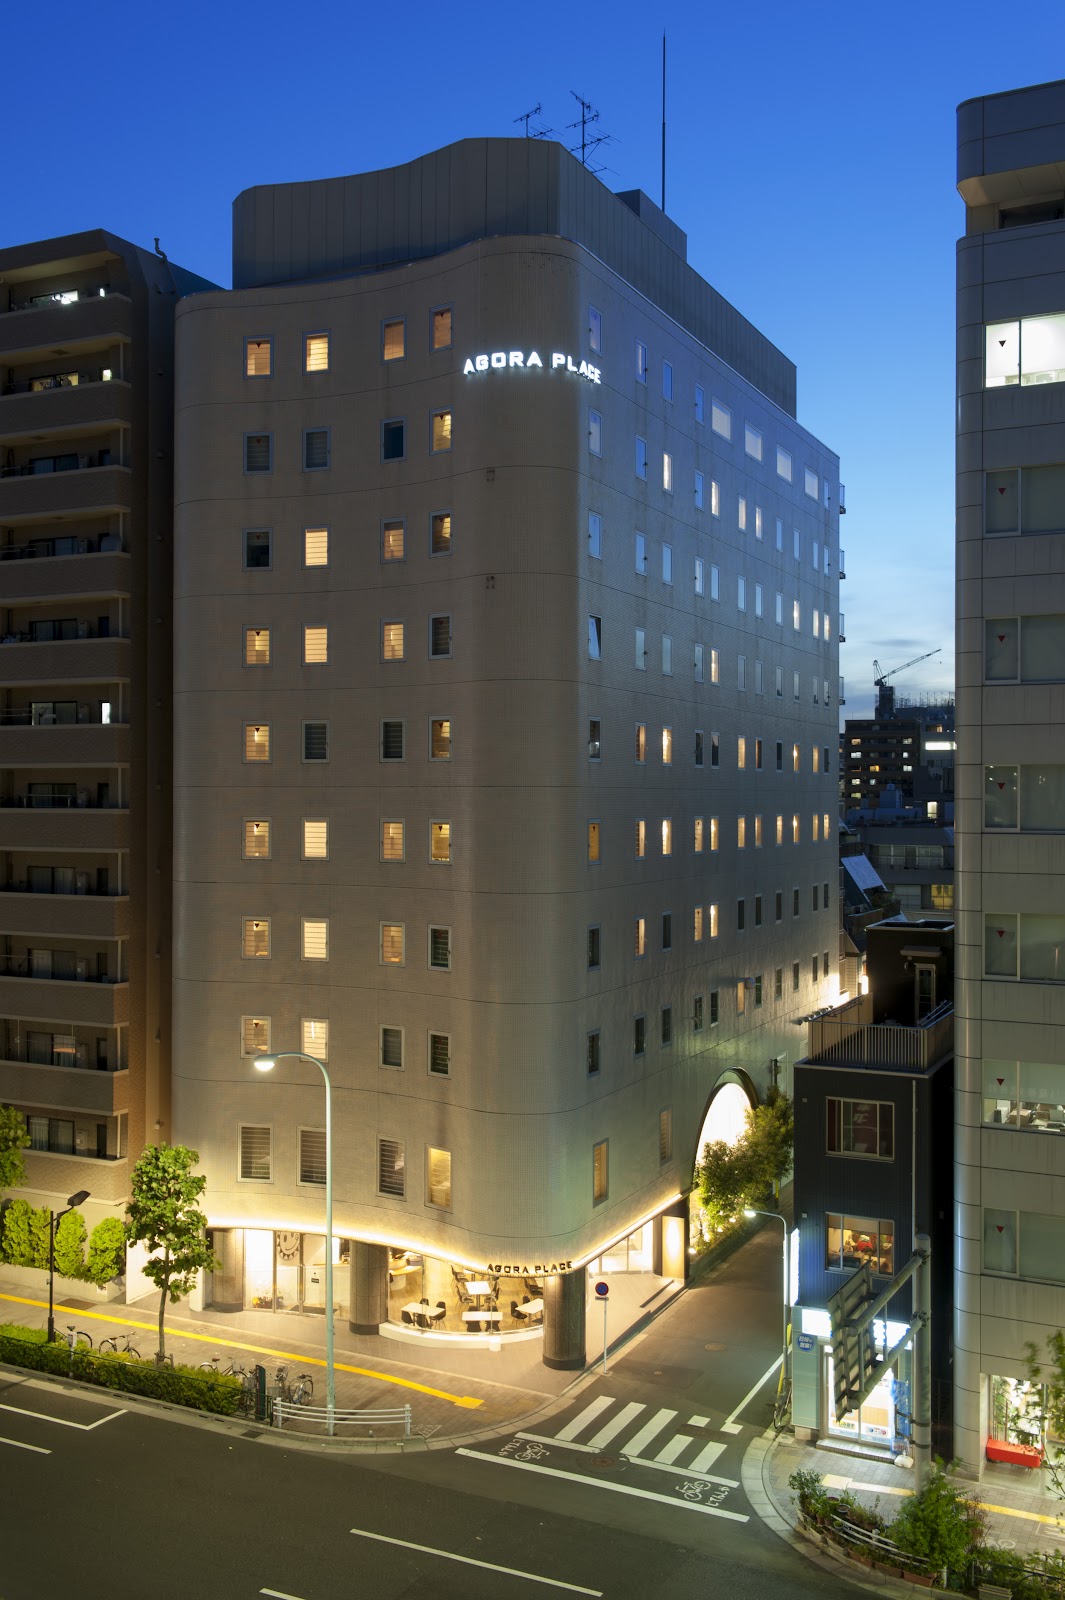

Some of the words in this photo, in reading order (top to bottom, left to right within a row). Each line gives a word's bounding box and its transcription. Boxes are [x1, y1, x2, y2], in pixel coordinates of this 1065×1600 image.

[463, 351, 543, 375] AGORA
[552, 352, 602, 384] PLACE
[487, 1263, 529, 1274] AGORA
[534, 1260, 572, 1273] PLACE
